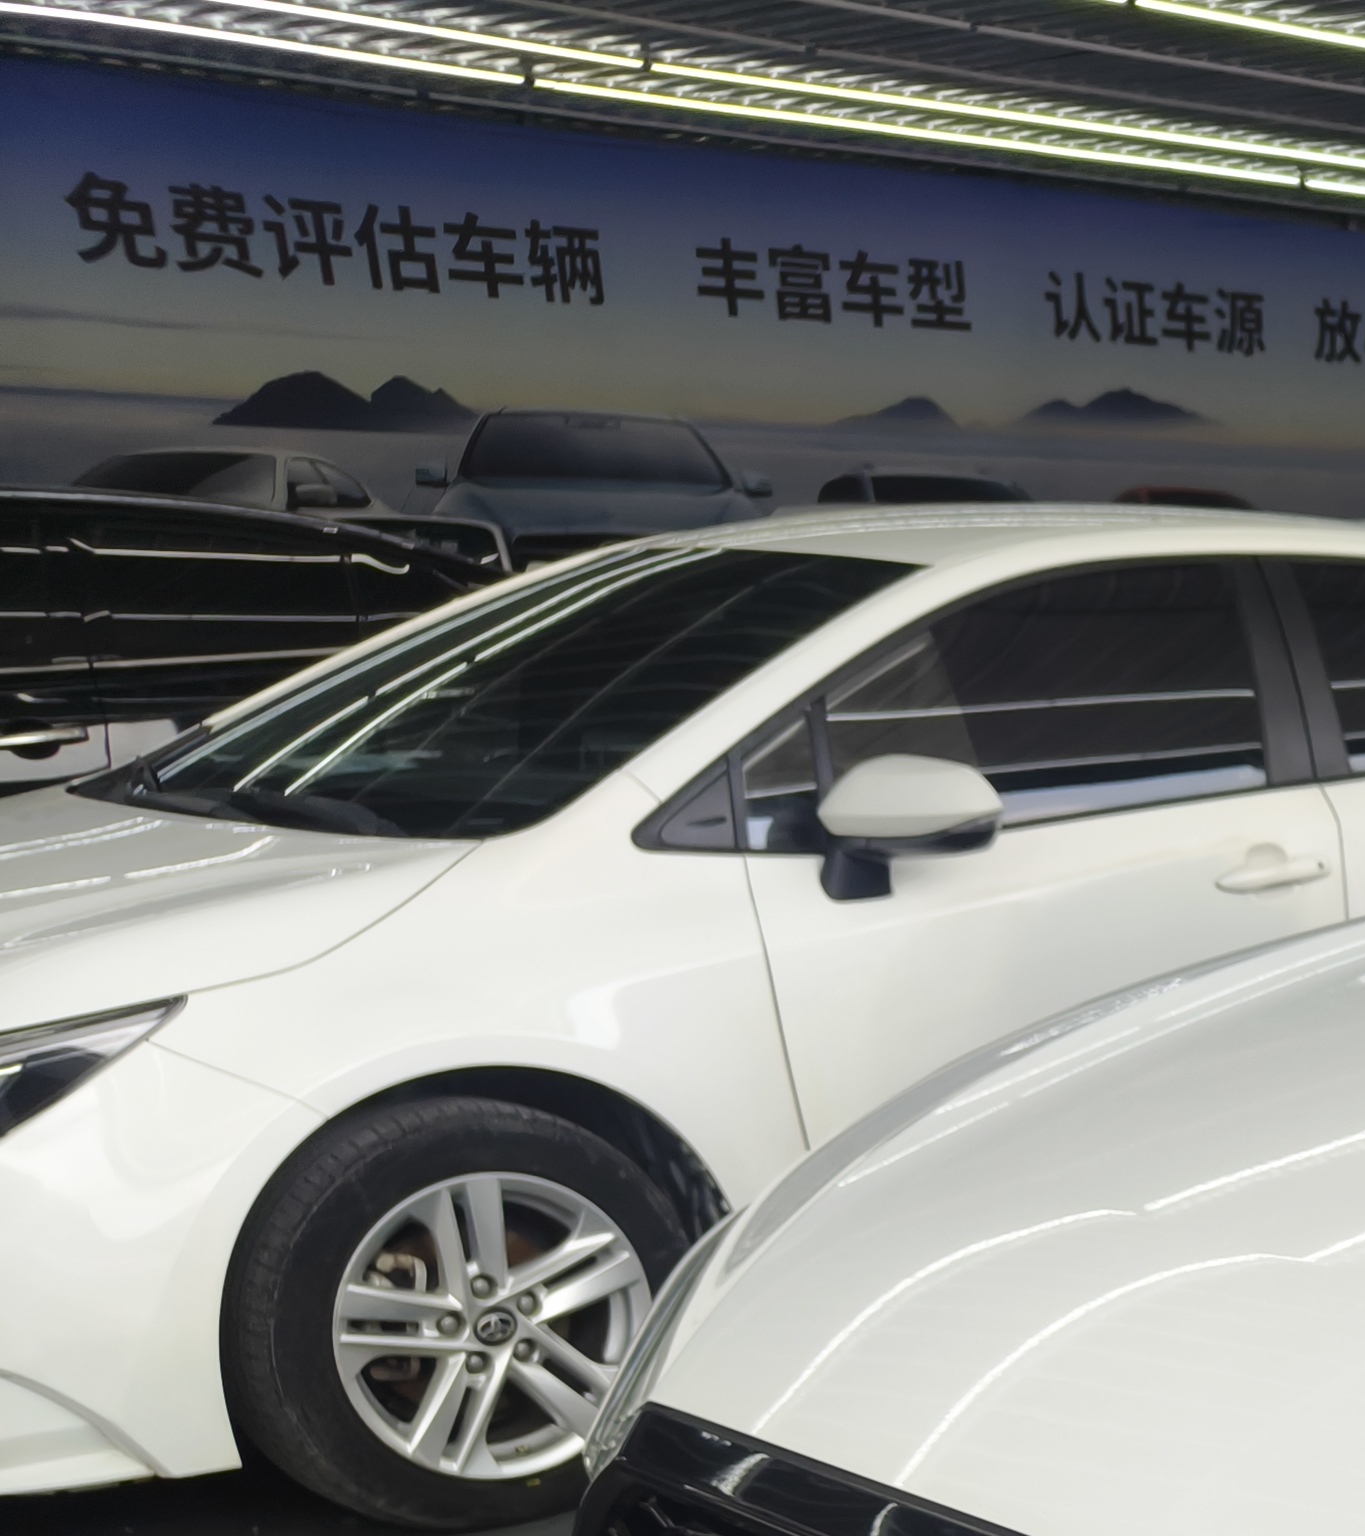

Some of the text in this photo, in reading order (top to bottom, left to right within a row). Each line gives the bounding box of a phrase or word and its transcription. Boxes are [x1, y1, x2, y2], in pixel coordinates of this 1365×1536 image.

[64, 170, 605, 306] 免费评估车辆
[695, 236, 973, 332] 丰富车型
[1044, 269, 1267, 358] 认证车源
